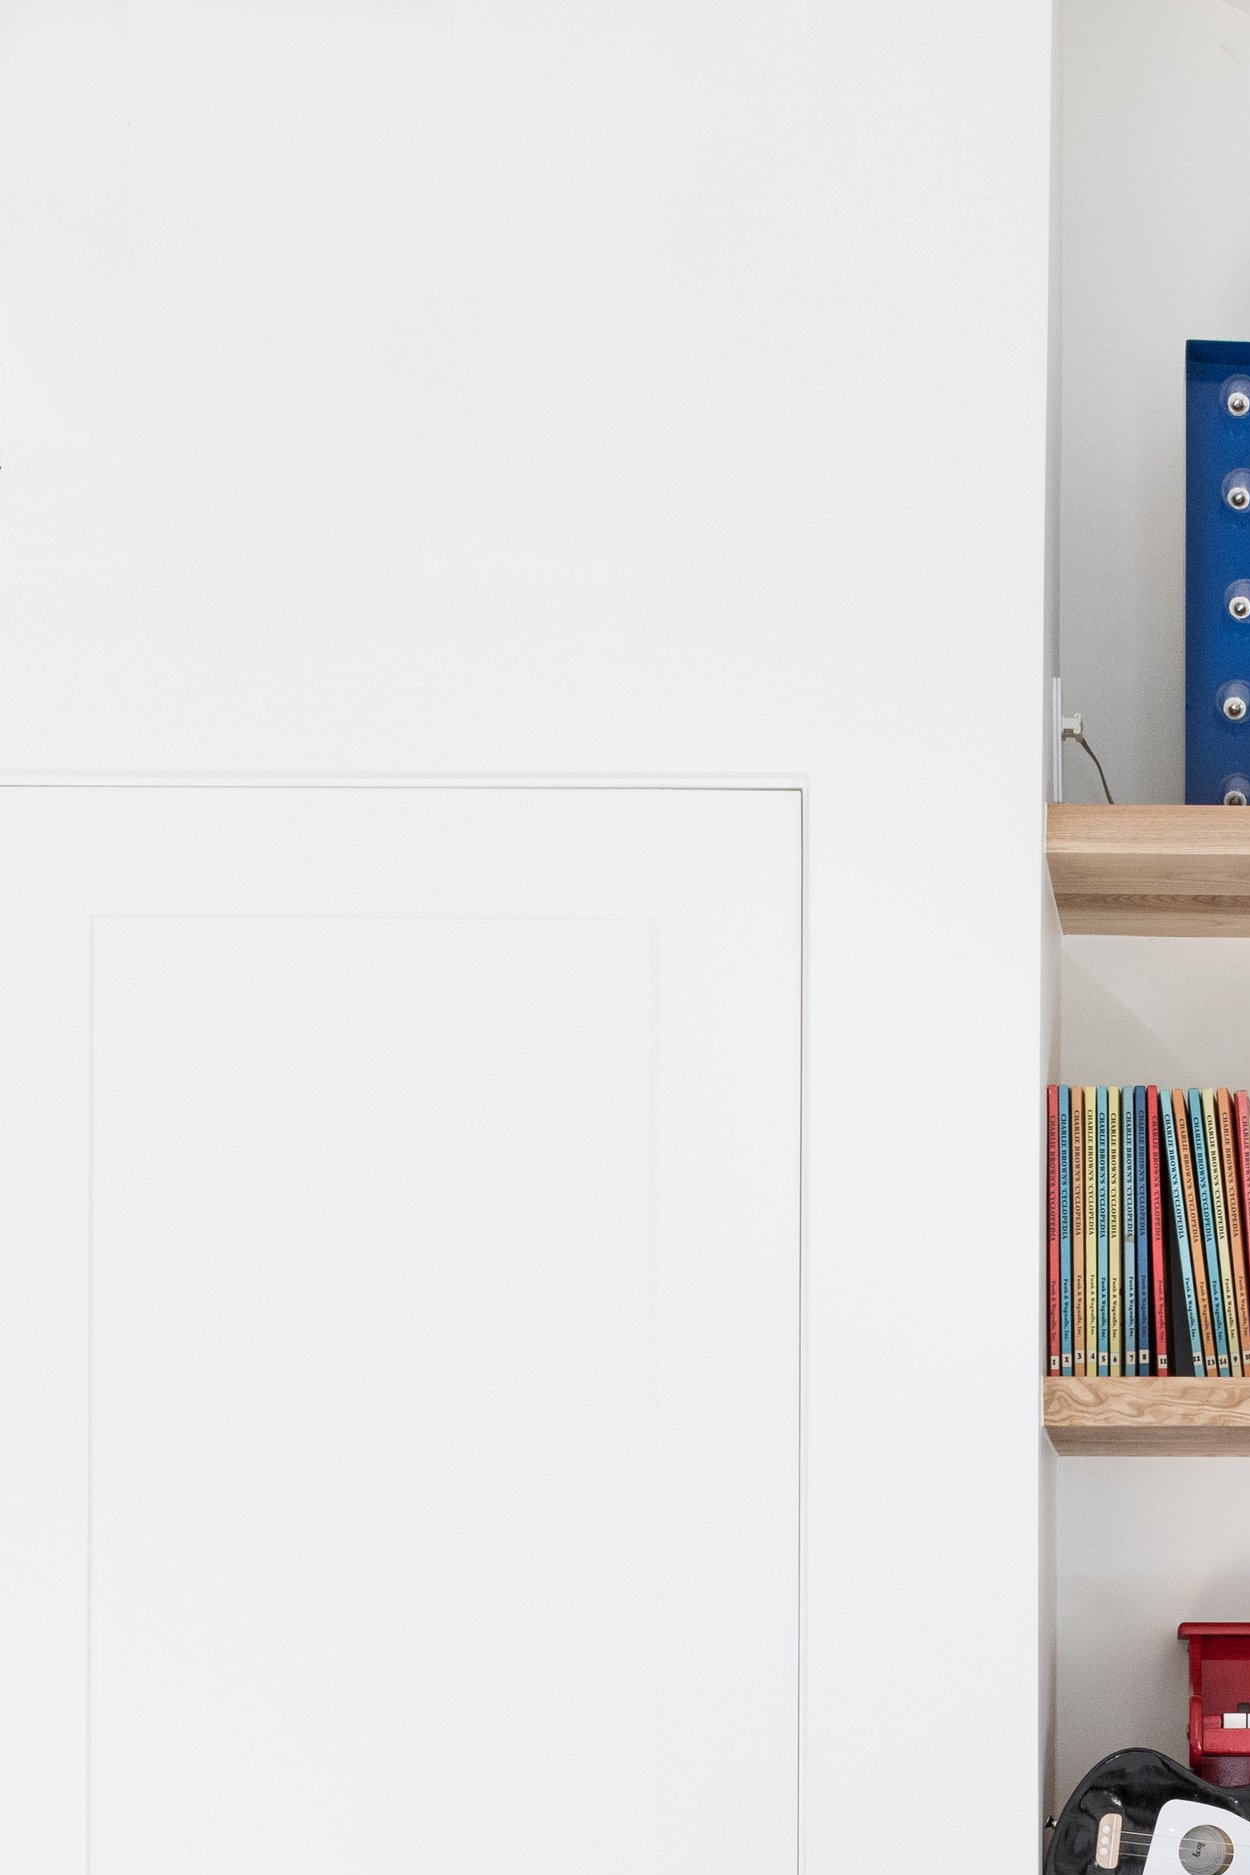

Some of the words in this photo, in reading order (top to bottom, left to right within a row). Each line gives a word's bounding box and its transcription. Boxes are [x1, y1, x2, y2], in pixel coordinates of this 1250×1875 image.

[1164, 1114, 1173, 1148] CHARLIE
[1179, 1118, 1188, 1152] CHARLIE
[1193, 1117, 1201, 1151] CHARLIE
[1206, 1115, 1215, 1149] CHARLIE
[1222, 1112, 1230, 1147] CHARLIE
